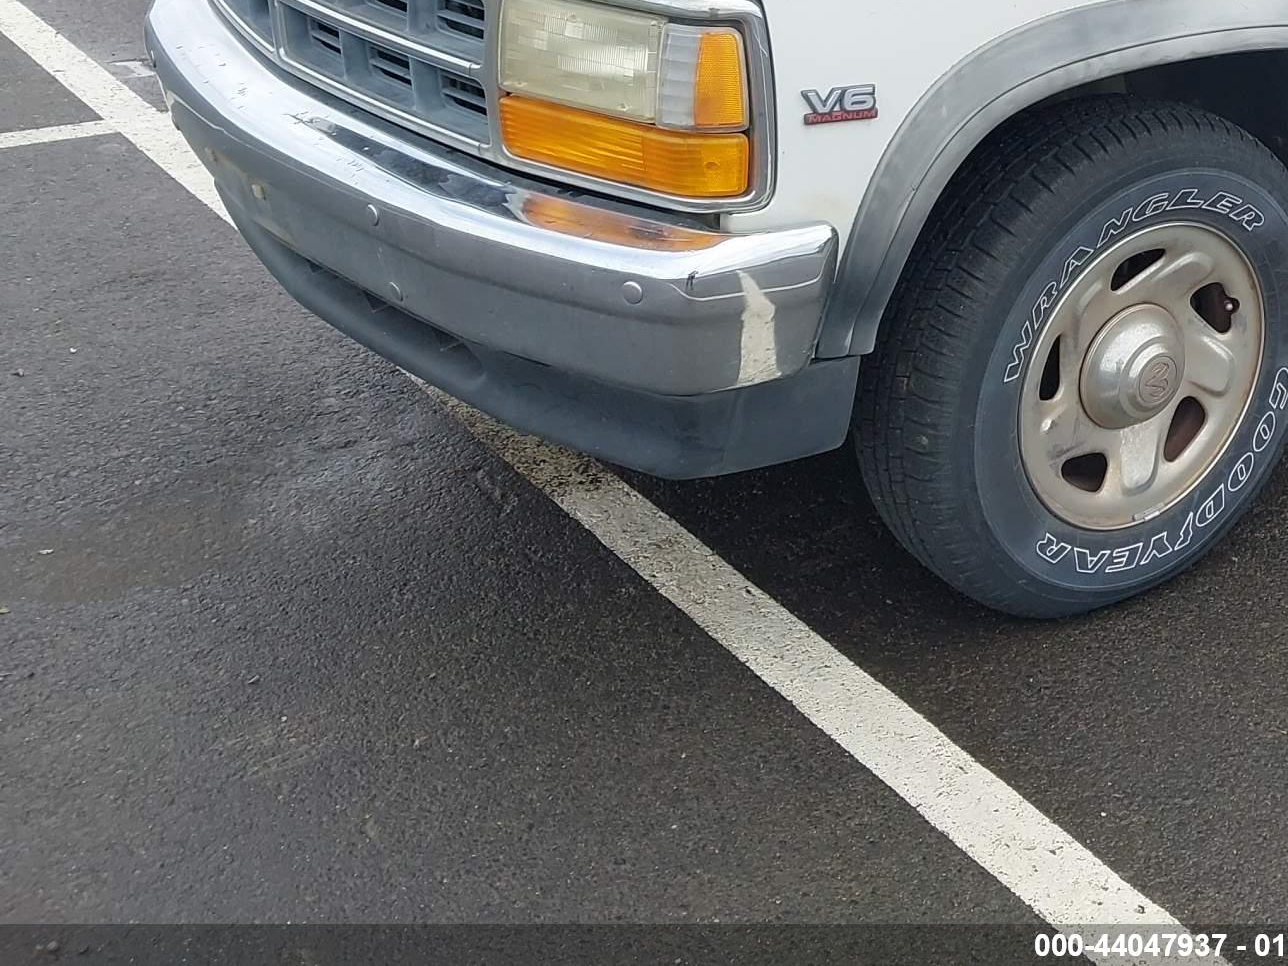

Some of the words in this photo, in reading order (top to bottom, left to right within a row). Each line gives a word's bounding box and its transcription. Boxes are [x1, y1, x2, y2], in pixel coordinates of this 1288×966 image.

[801, 84, 876, 113] V6
[807, 110, 877, 124] MAGNUM
[1003, 188, 1265, 383] WRANGLER
